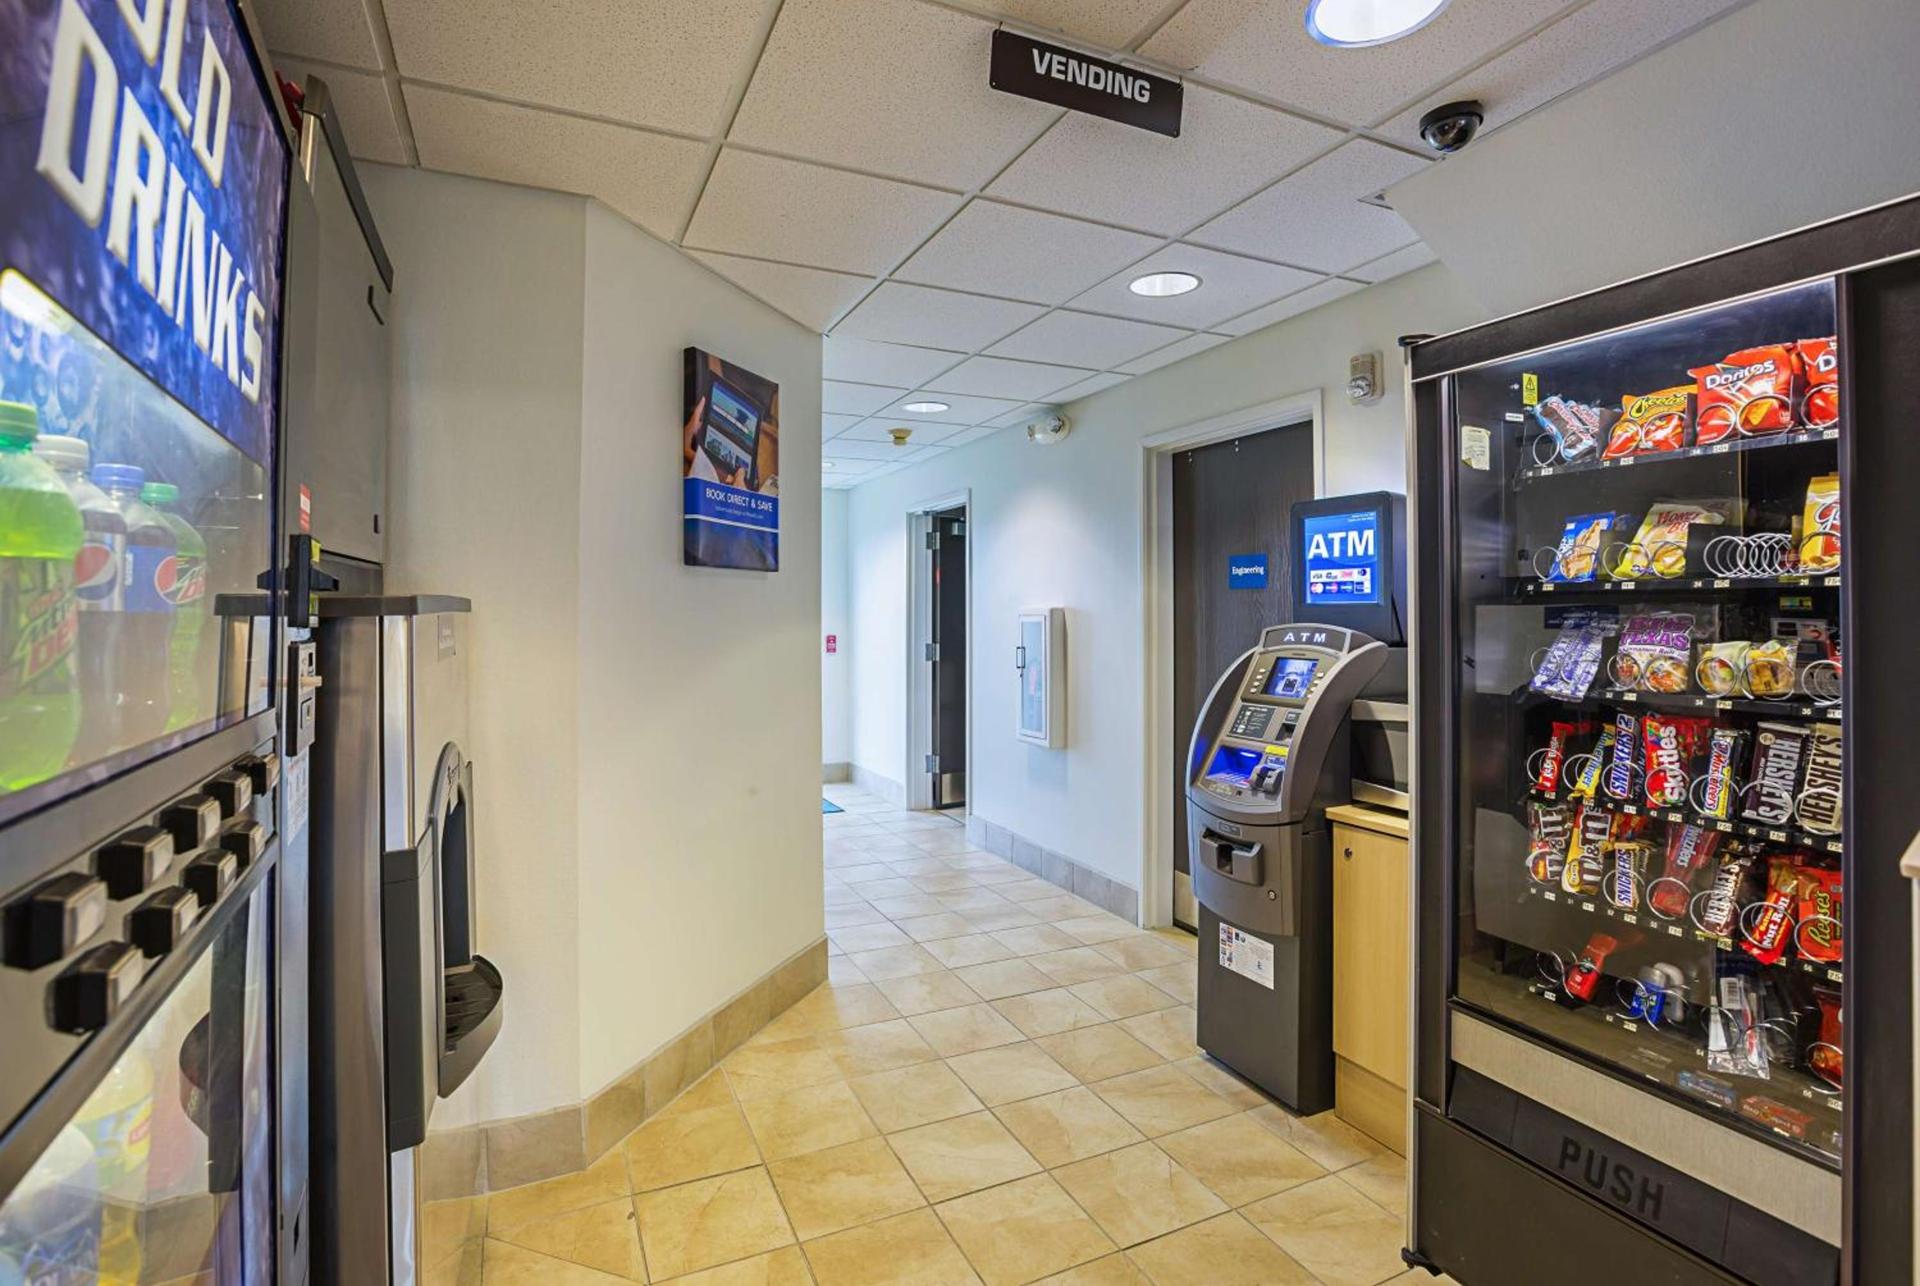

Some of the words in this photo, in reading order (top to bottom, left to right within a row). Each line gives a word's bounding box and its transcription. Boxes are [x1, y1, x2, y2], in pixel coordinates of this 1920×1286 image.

[1031, 47, 1151, 104] VENDING
[35, 0, 265, 403] DRINKS
[1705, 359, 1778, 390] Doritos
[705, 487, 726, 502] BOOK
[727, 493, 749, 507] DIRECT
[751, 499, 756, 509] &
[757, 500, 773, 512] SAVE
[1232, 565, 1265, 575] Engineering
[1308, 529, 1375, 560] ATM
[1283, 632, 1326, 642] ATM
[1619, 631, 1691, 651] TEXAS
[1618, 715, 1629, 729] 2
[1610, 731, 1633, 796] SNICKERS
[1657, 726, 1688, 802] Skittles
[1704, 751, 1726, 812] Musketeers
[1757, 738, 1802, 820] HERSHEY'S
[1799, 734, 1842, 825] HERSHEY'S
[1677, 824, 1704, 867] Twizzlers
[1617, 848, 1631, 905] SNICKERS
[1703, 862, 1740, 925] HERSHEY'S
[1762, 920, 1780, 948] Nut
[1772, 895, 1791, 922] Roll
[1808, 891, 1831, 948] Reese's
[1557, 1136, 1664, 1221] PUSH
